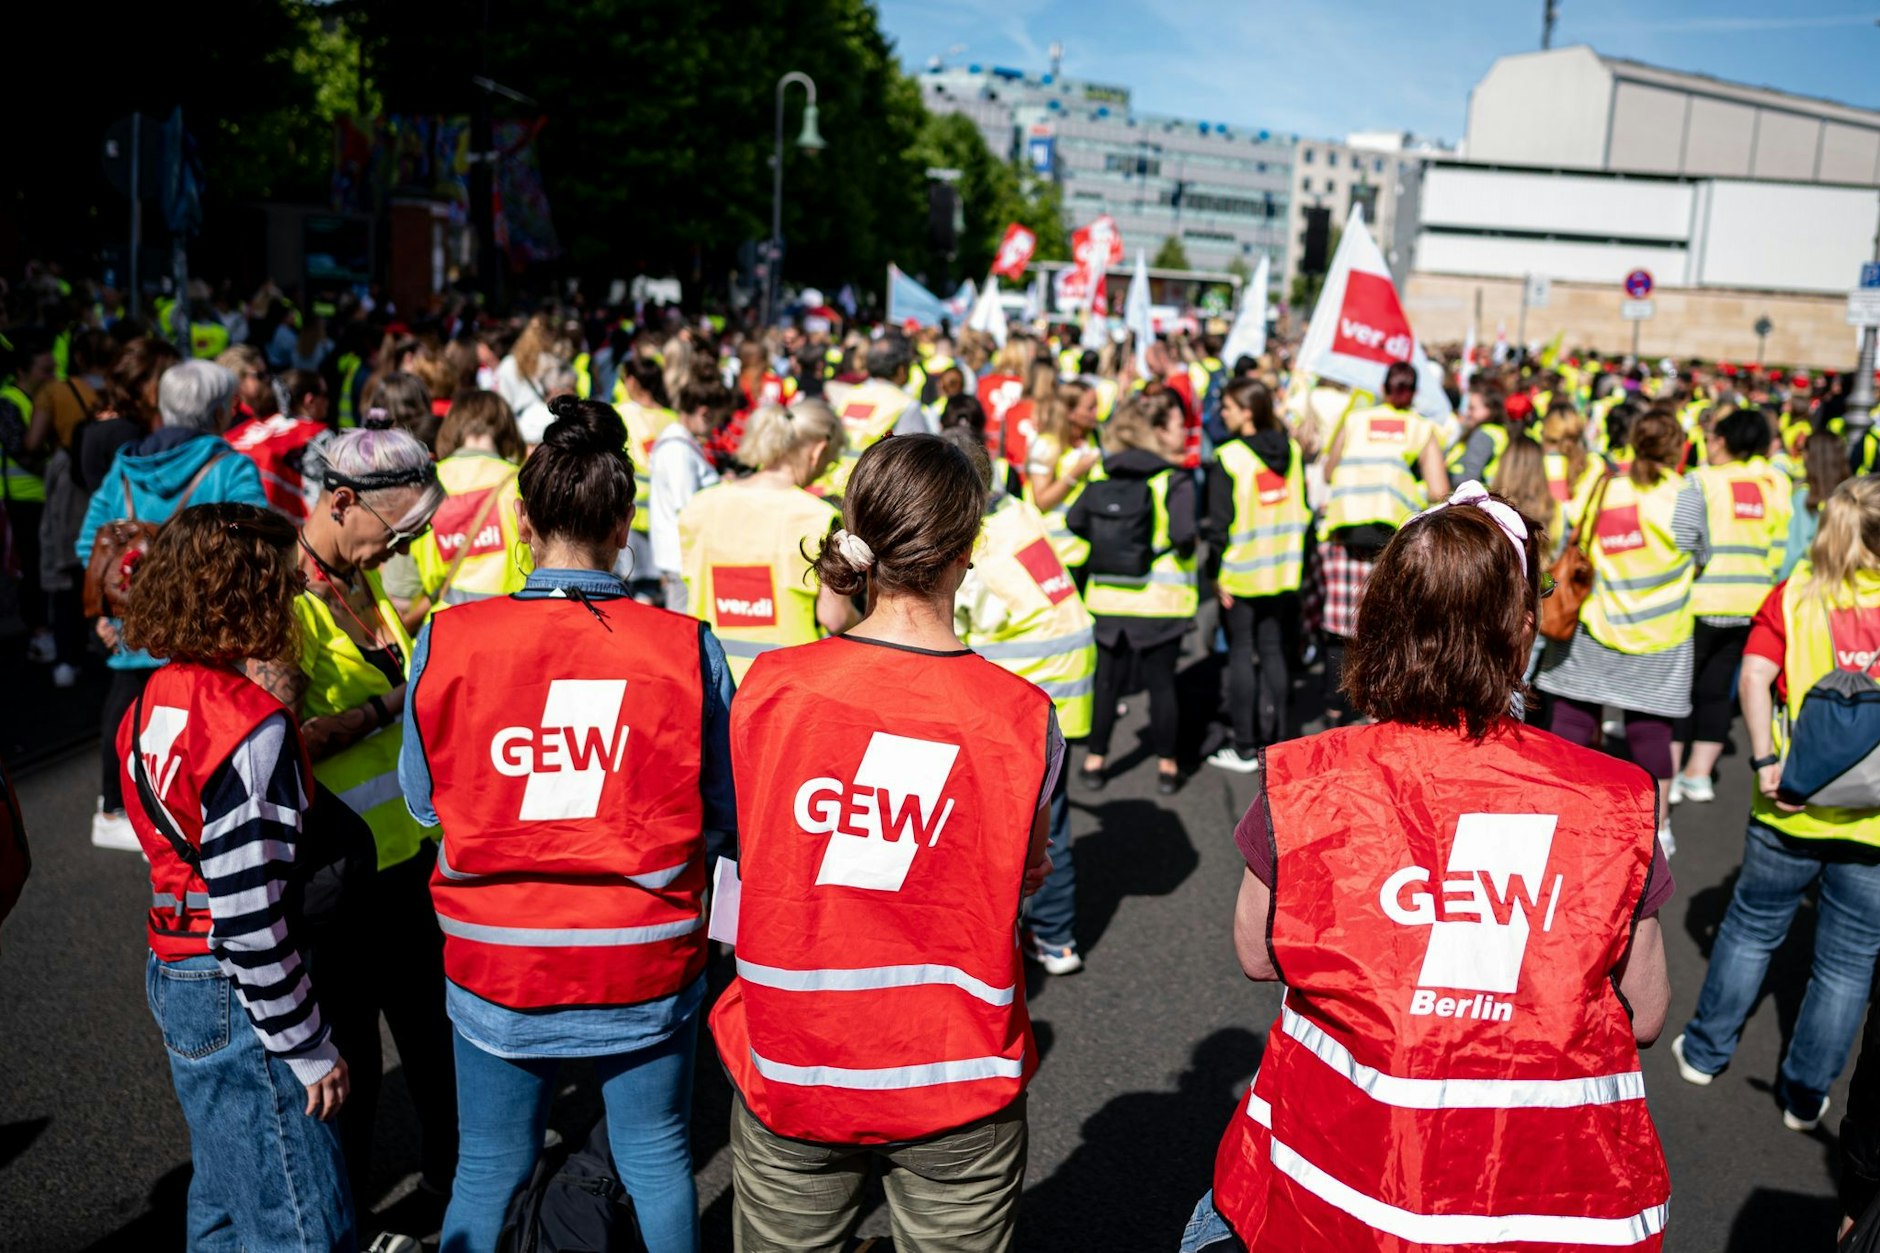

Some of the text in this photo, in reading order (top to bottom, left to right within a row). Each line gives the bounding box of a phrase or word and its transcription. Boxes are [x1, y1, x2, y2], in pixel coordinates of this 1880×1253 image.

[438, 525, 501, 550] ve.di
[716, 597, 773, 618] ver.di
[490, 725, 630, 778] GEW
[793, 776, 956, 848] GEW
[1379, 865, 1564, 933] GEW
[1409, 989, 1513, 1022] Berlin
